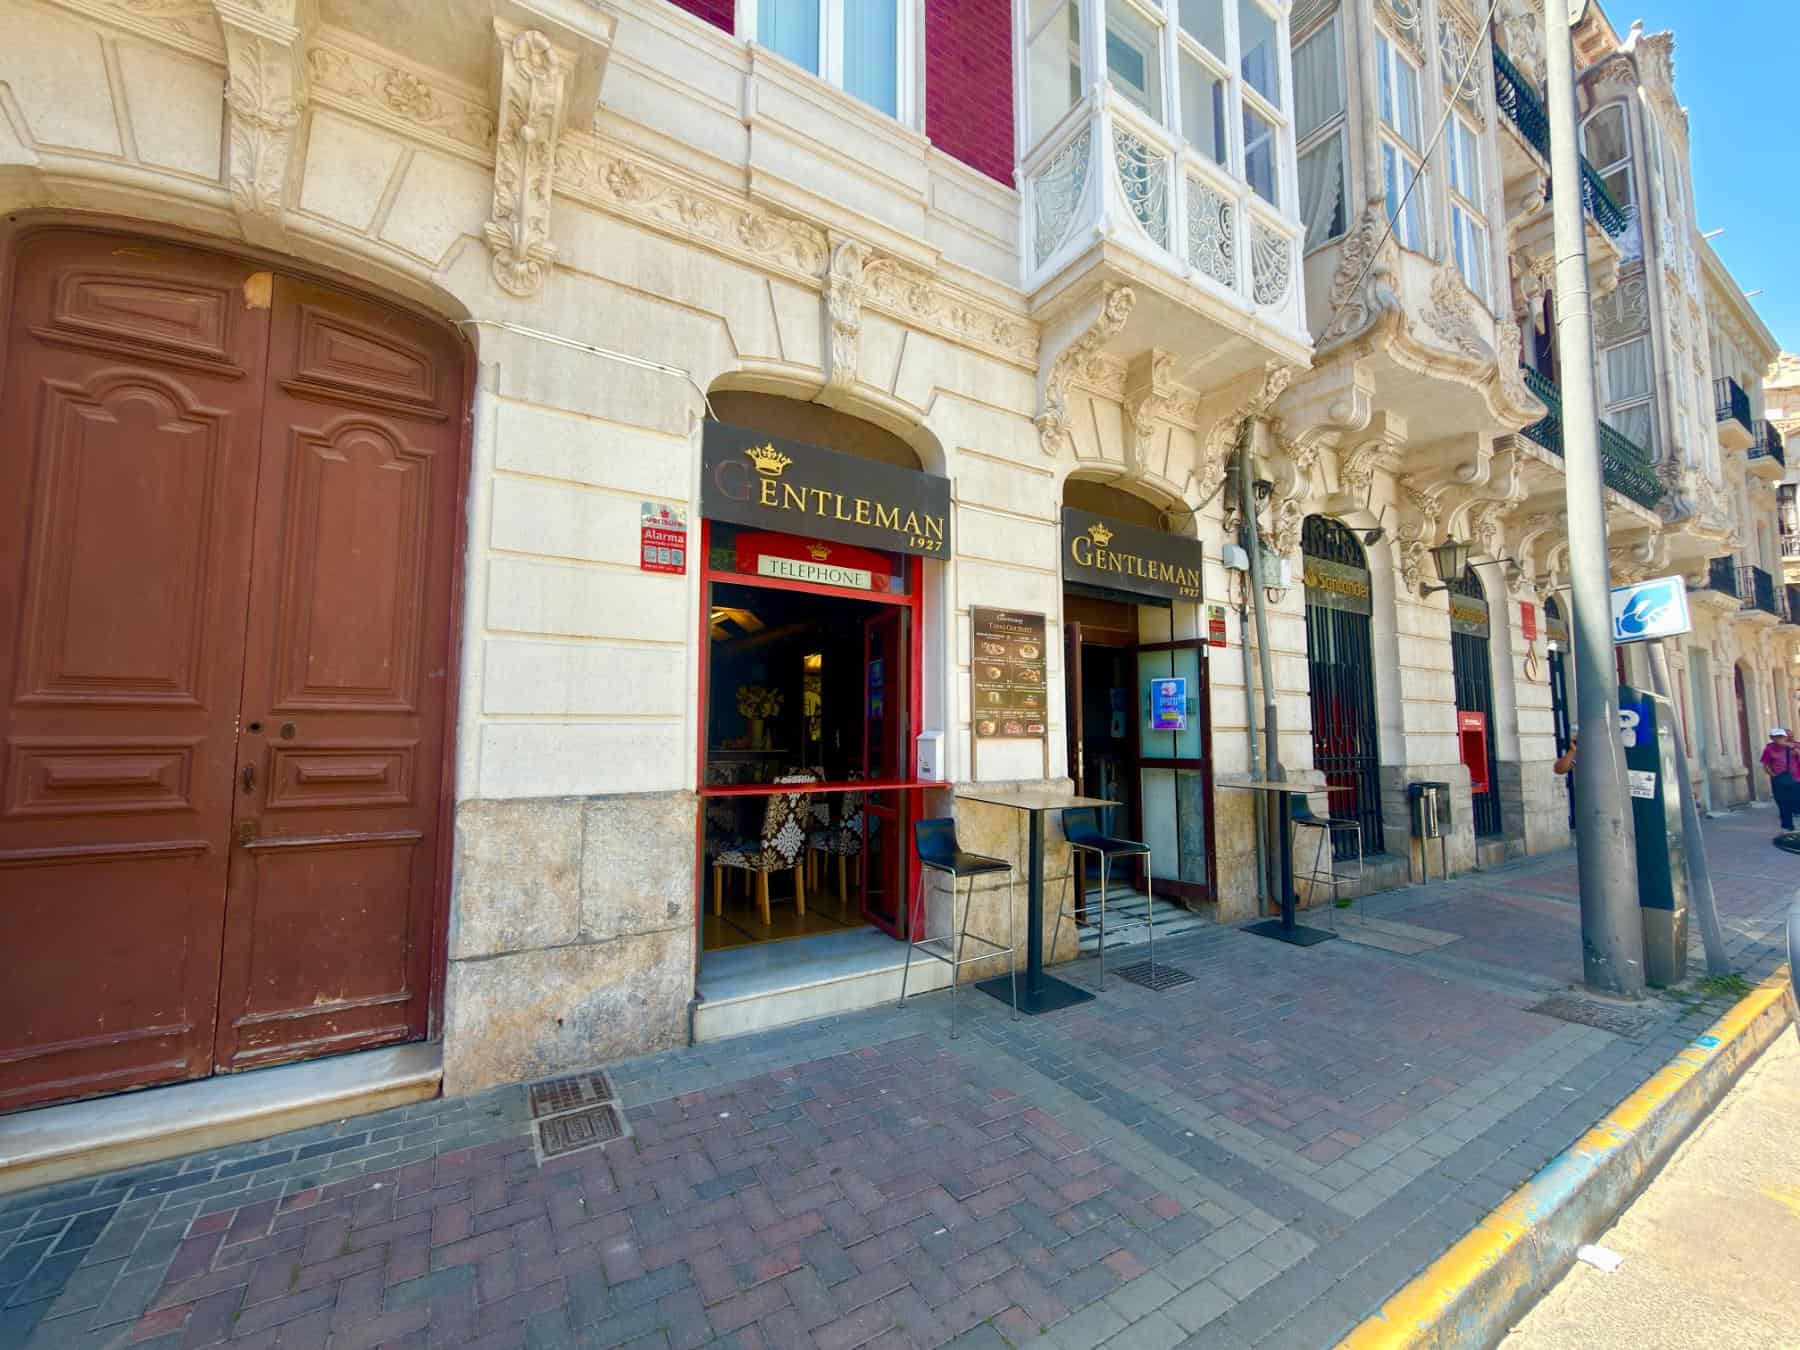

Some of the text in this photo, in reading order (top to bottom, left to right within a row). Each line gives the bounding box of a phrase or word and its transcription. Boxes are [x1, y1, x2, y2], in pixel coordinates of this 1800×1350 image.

[645, 529, 685, 544] Alarma
[909, 534, 943, 552] 1927
[1071, 535, 1200, 588] GENTLEMAN
[768, 558, 864, 587] TELEPHONE
[1179, 585, 1200, 598] 1927
